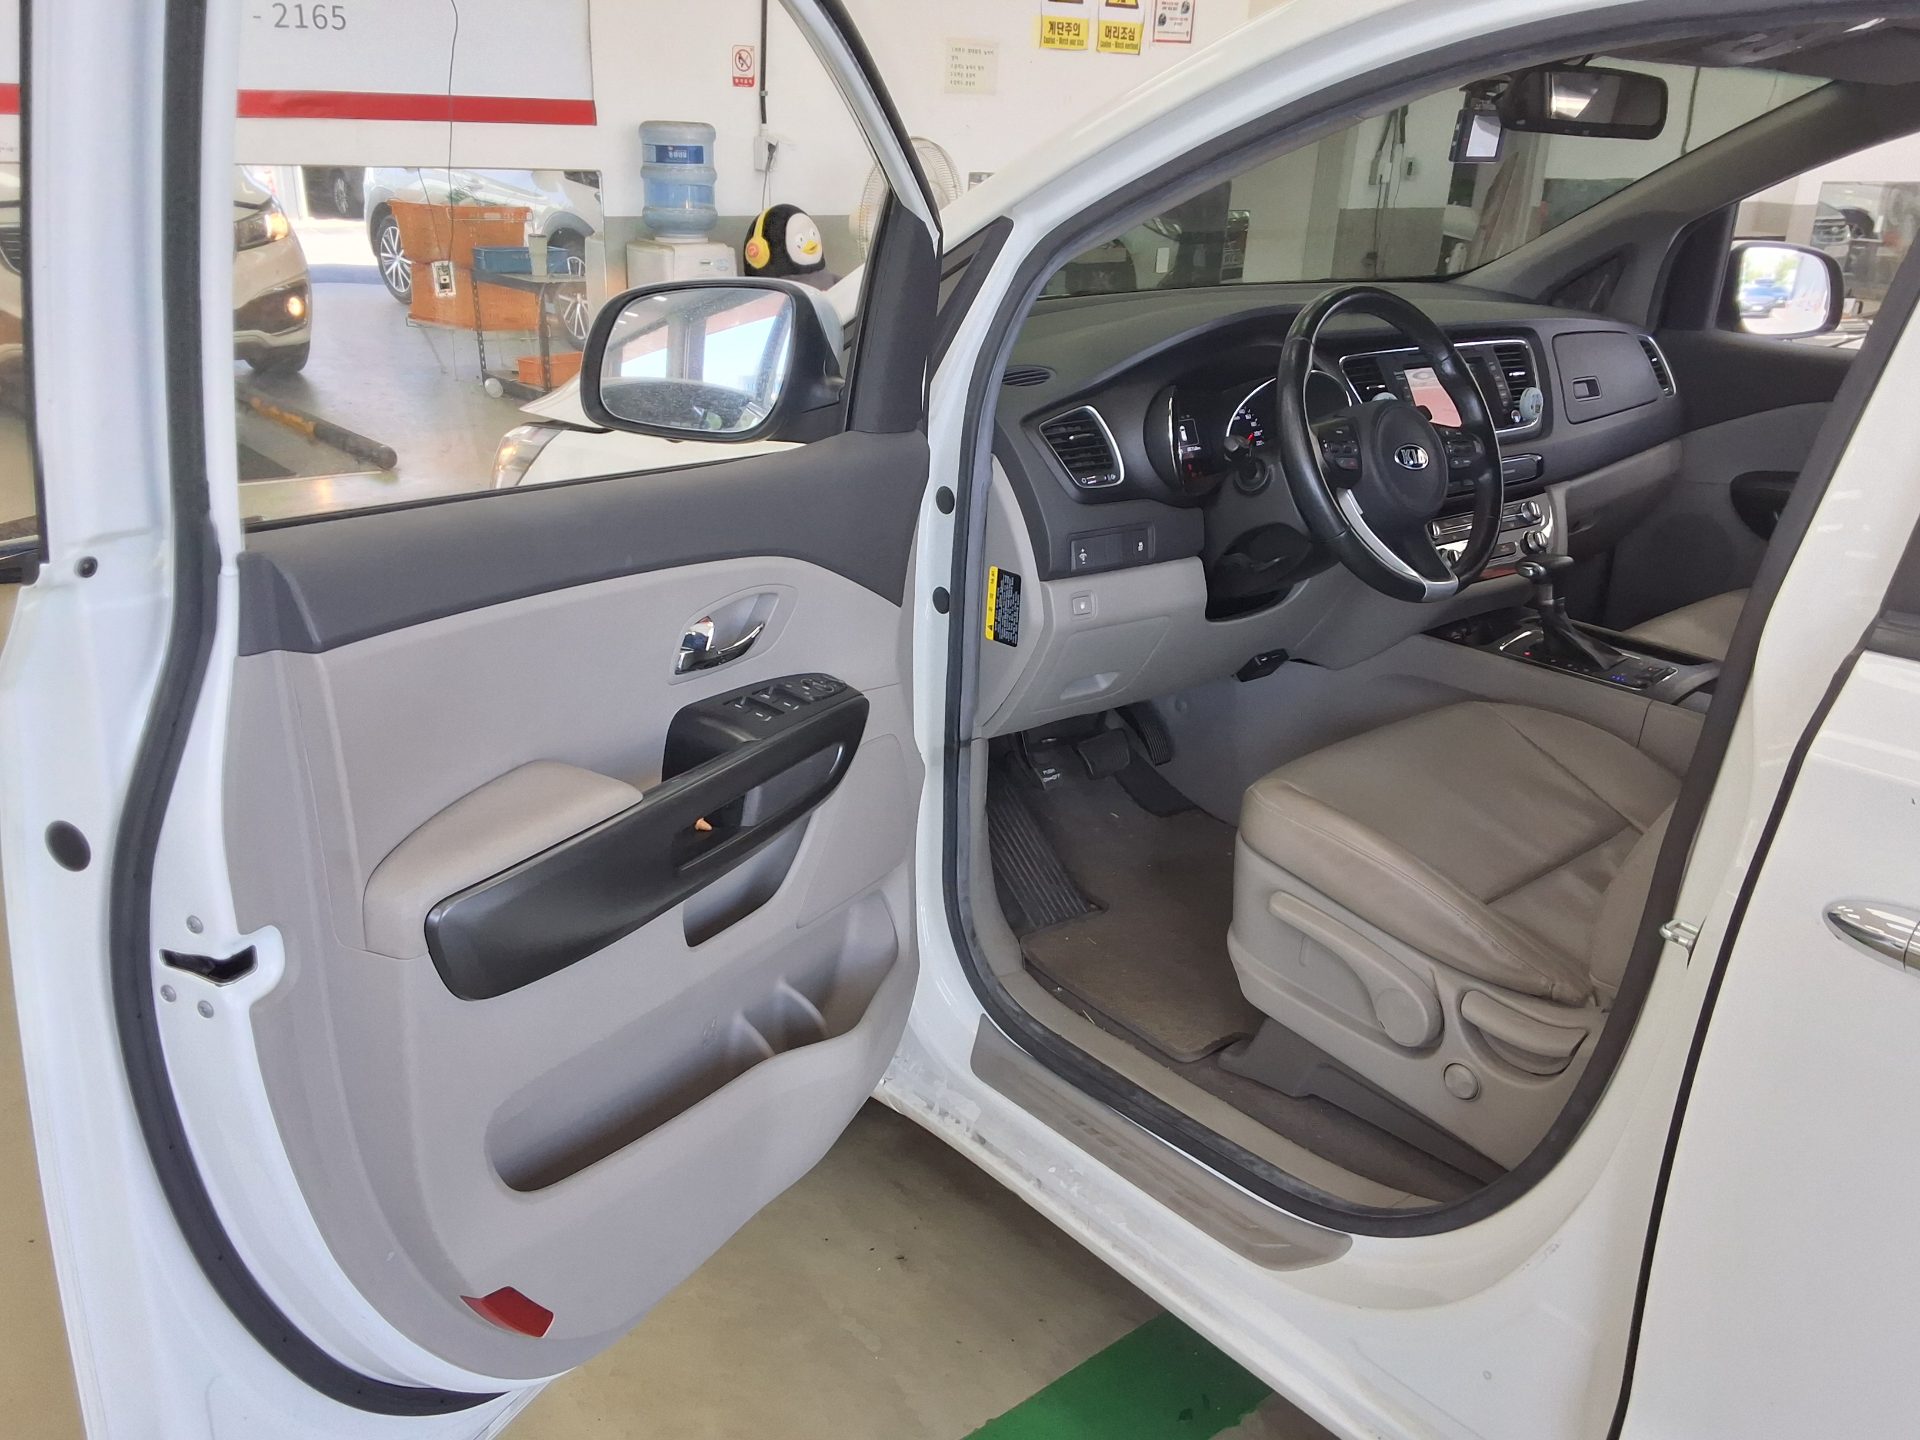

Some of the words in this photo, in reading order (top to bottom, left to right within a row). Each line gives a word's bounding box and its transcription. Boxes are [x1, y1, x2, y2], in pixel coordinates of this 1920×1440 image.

[272, 3, 347, 30] 2165
[1048, 21, 1081, 37] 계단주의
[1104, 25, 1136, 41] 머리조심
[1400, 449, 1428, 464] KIA
